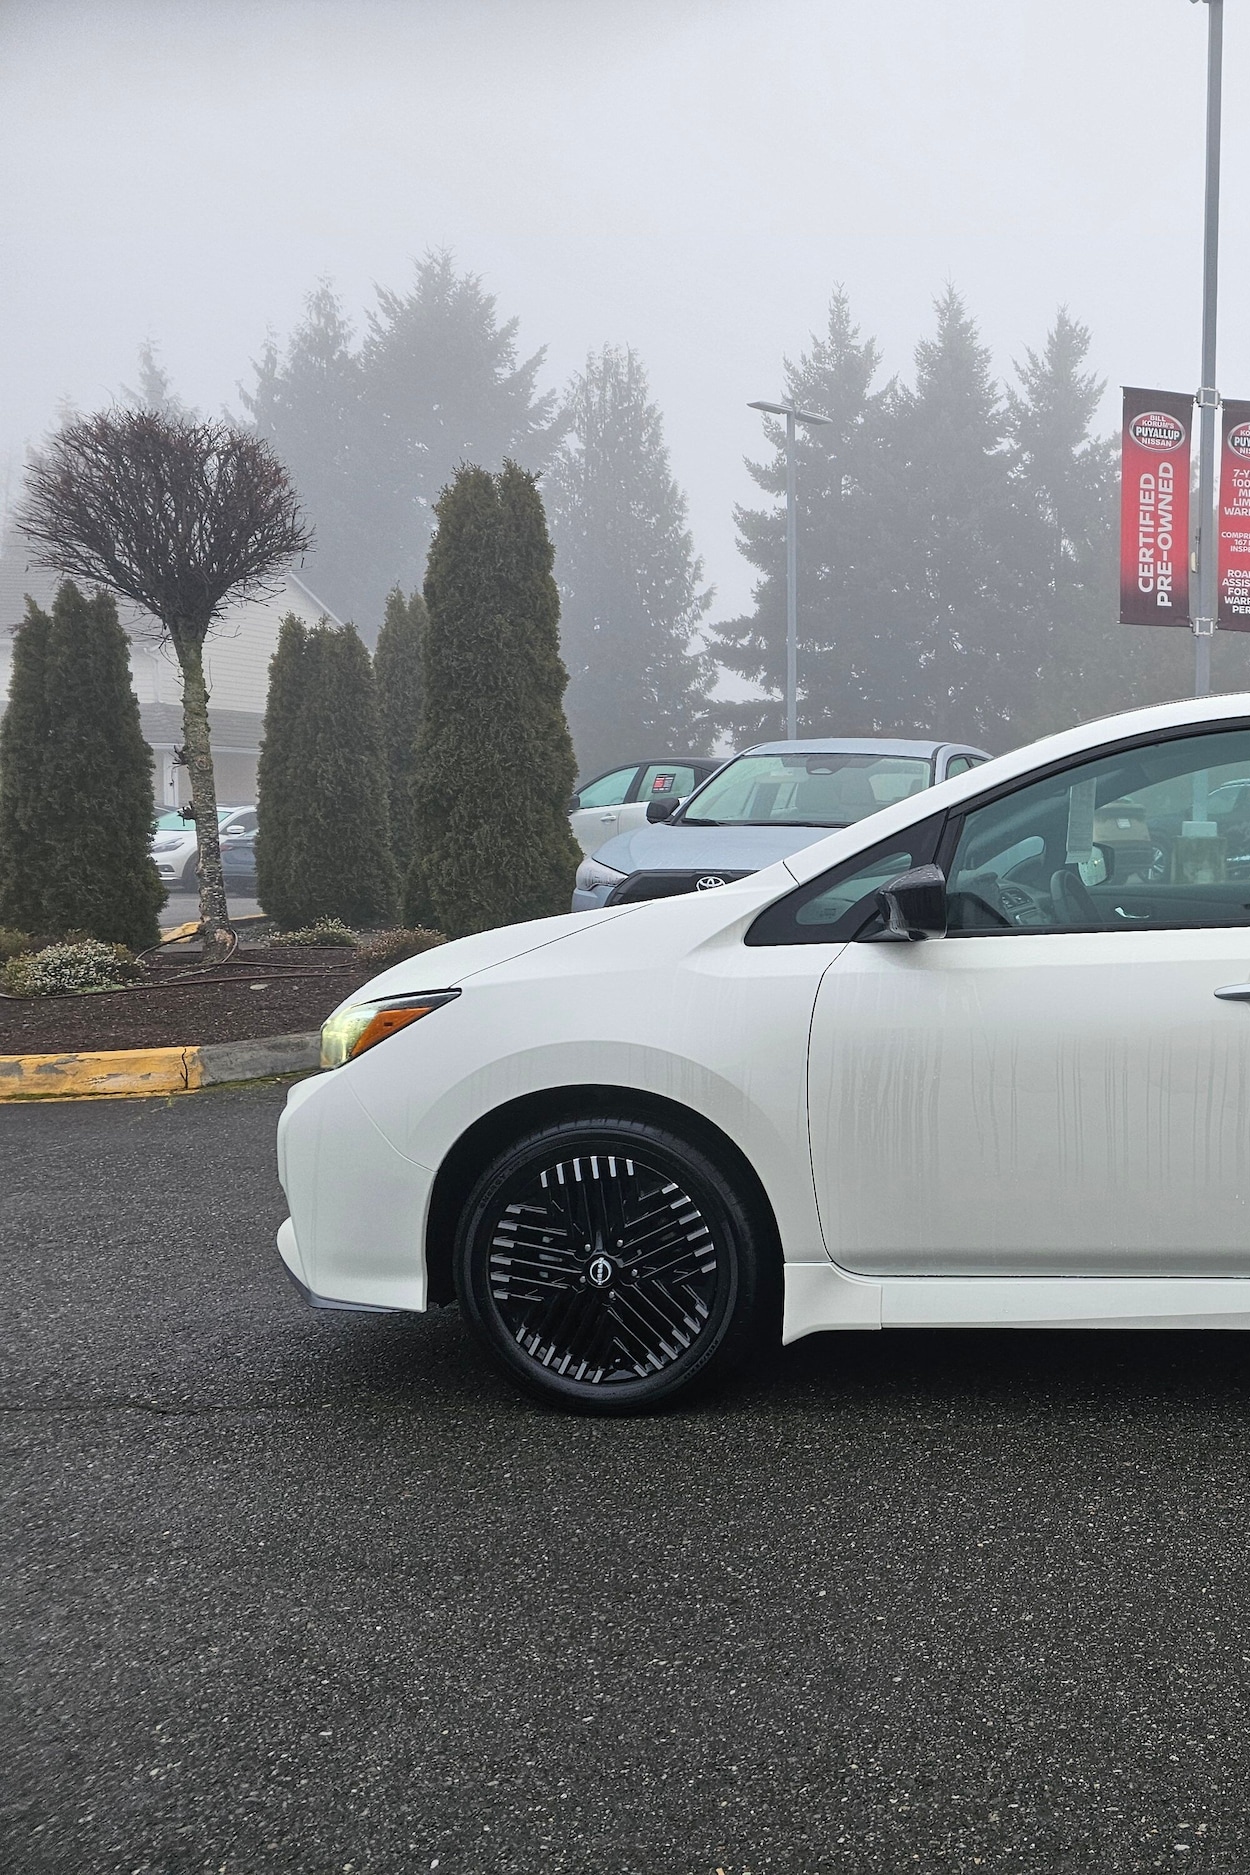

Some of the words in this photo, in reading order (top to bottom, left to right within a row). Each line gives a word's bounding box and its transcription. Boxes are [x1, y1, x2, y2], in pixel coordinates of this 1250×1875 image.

[1142, 420, 1175, 429] KORUM'S
[1135, 426, 1180, 440] PUYALLUP
[1142, 438, 1172, 447] NISSAN
[1138, 473, 1155, 593] CERTIFIED
[1157, 462, 1174, 607] PRE-OWNED
[1228, 587, 1248, 596] FOR
